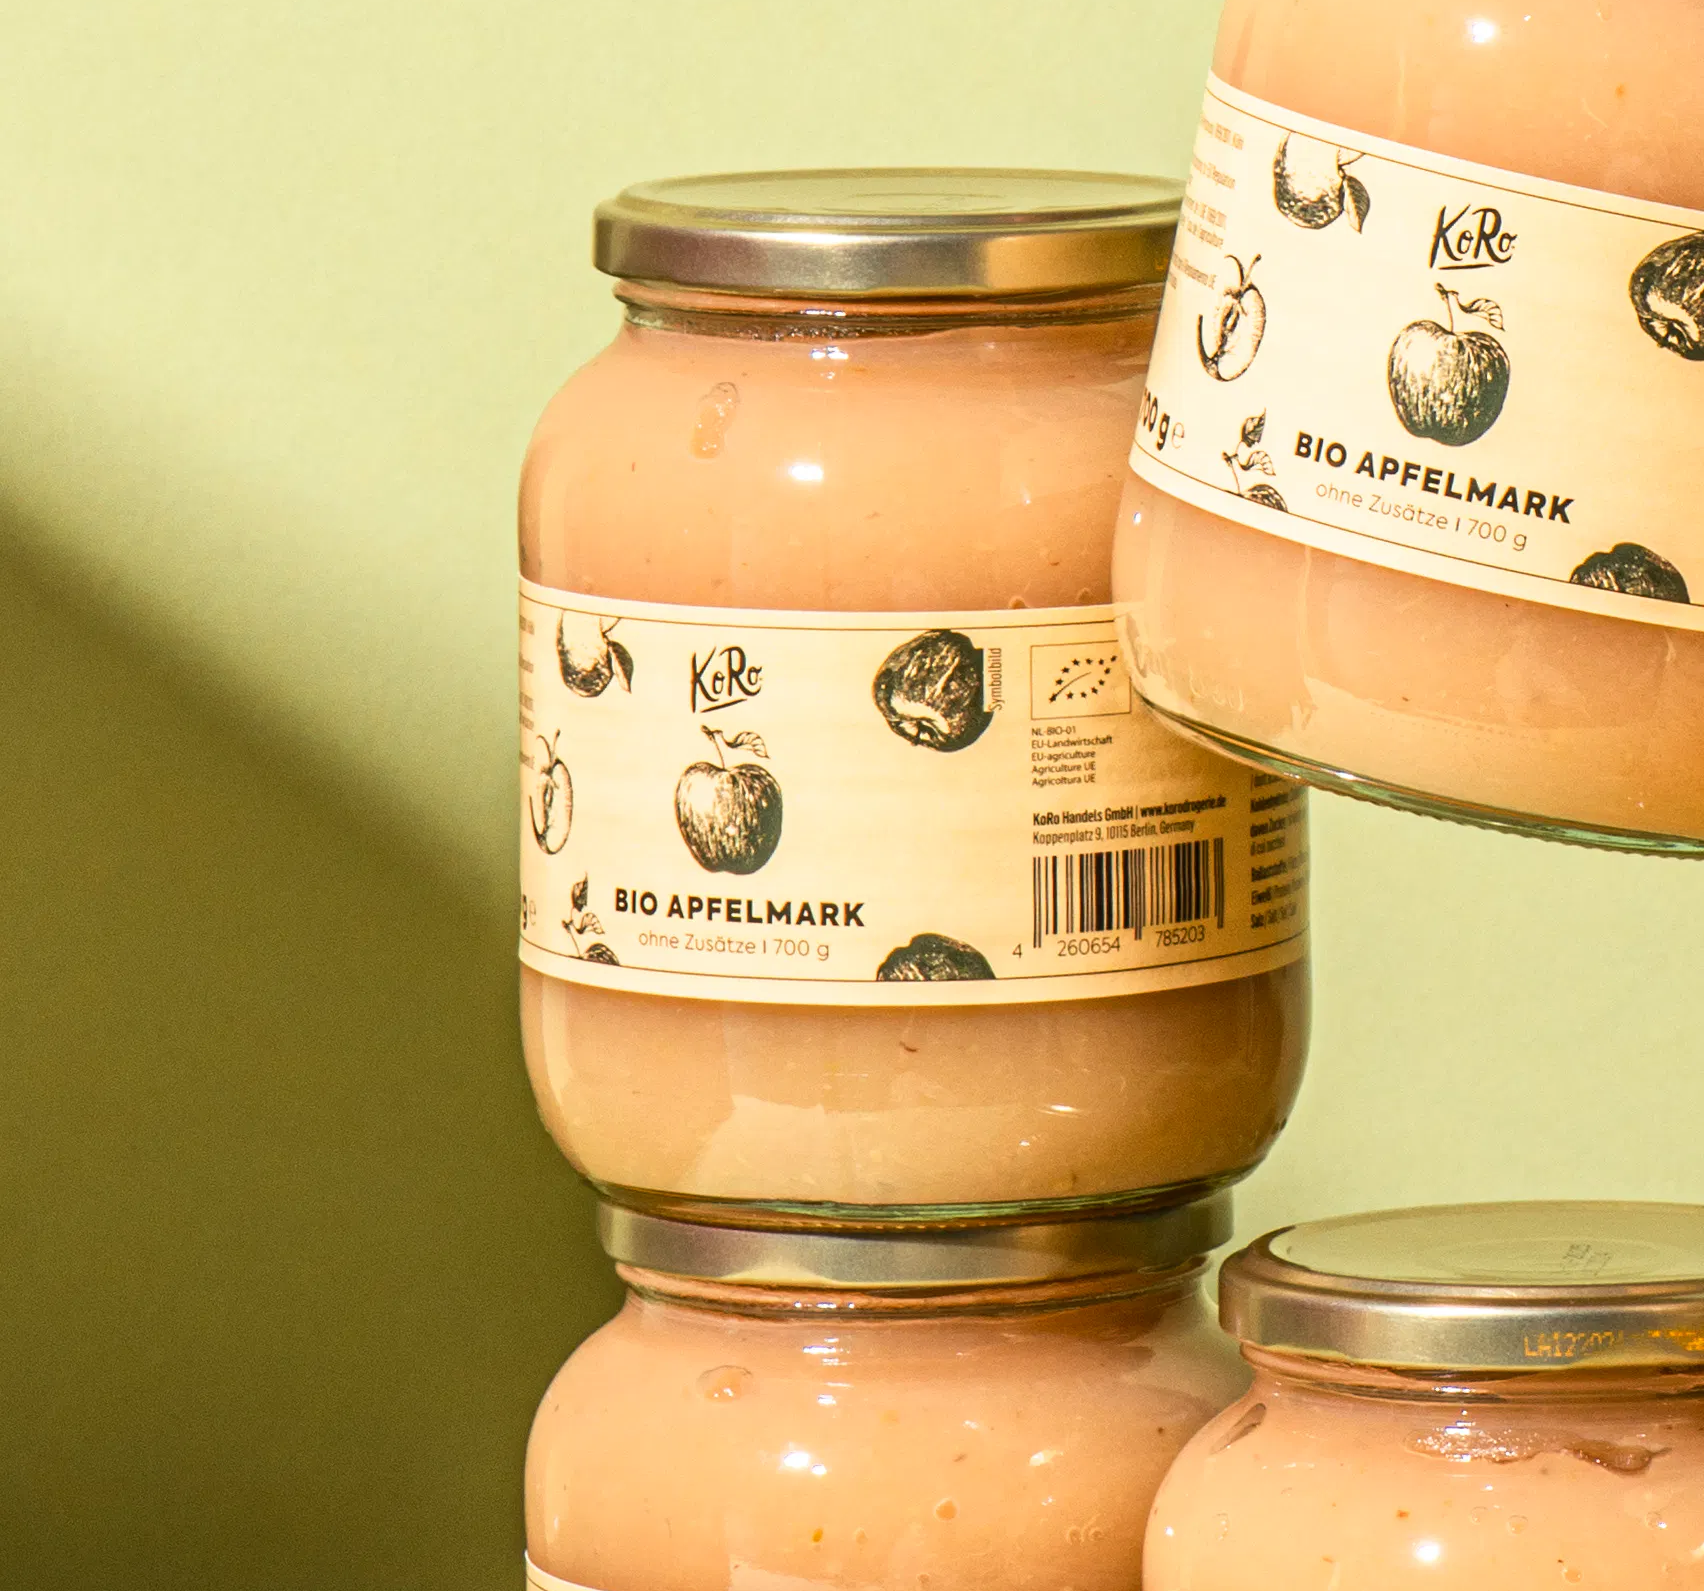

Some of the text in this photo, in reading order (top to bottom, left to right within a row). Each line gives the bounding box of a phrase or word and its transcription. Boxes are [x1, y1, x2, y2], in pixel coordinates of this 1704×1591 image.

[1428, 203, 1518, 270] KoRo
[1294, 431, 1576, 525] BIO APFELMARK
[1316, 482, 1528, 552] ohne Zusätze 700 g
[691, 646, 762, 713] KoRo
[988, 647, 1005, 711] Symbolbild
[1031, 725, 1076, 736] NL-BIO-01
[1031, 736, 1113, 749] EU-Landwirtschaft
[1031, 749, 1096, 762] EU-agriculture
[1031, 762, 1096, 776] Agriculture UE
[1031, 774, 1096, 789] Agricoltura UE
[1033, 812, 1060, 826] KoRo
[1062, 810, 1103, 824] Handels
[1104, 808, 1133, 822] GmbH
[1032, 828, 1093, 846] Koppenplatz
[1106, 825, 1128, 840] 10115
[1160, 819, 1195, 835] Germany
[615, 888, 865, 927] BIO APFELMARK
[638, 931, 830, 961] ohne Zusätze 700 g
[1012, 925, 1206, 959] 4 260654 785203
